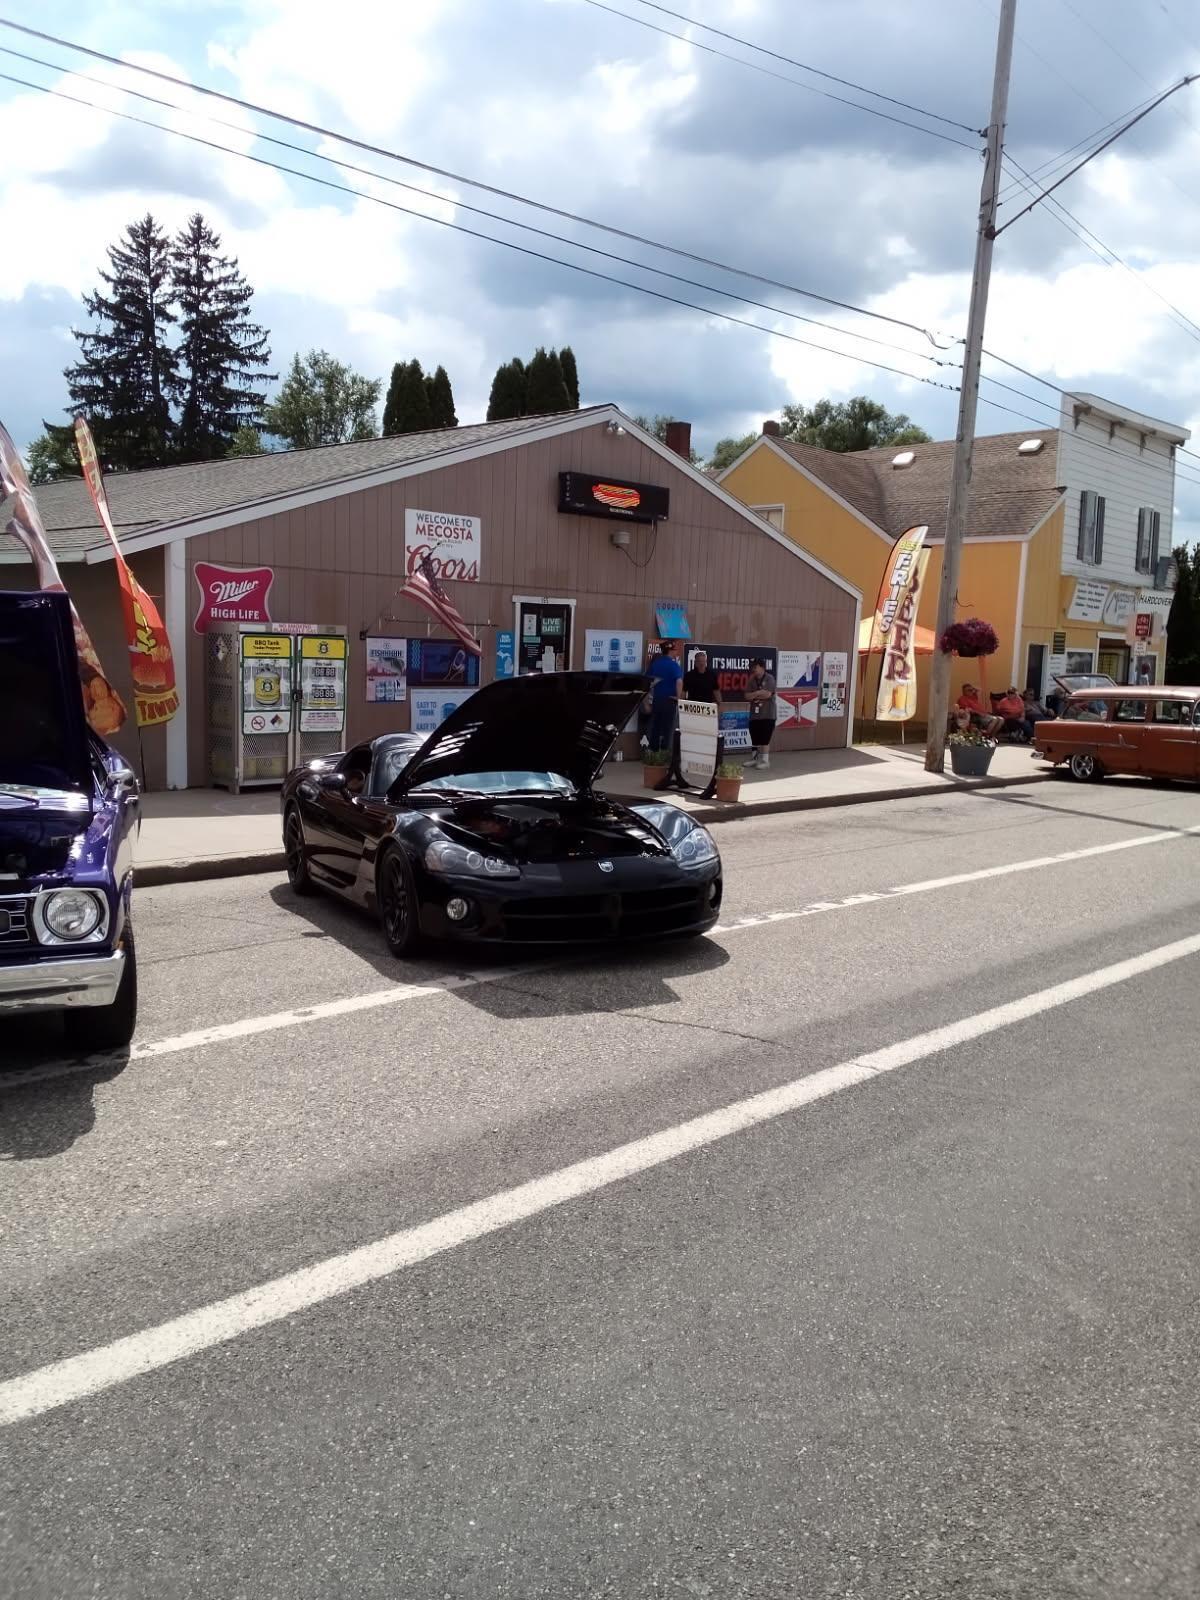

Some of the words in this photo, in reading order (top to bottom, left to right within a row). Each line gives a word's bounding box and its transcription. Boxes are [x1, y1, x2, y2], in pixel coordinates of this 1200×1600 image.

[416, 513, 460, 526] WELCOME
[462, 519, 472, 528] TO
[415, 523, 473, 541] MECOSTA
[406, 544, 478, 581] Coors
[209, 580, 259, 603] Miller
[880, 552, 913, 633] FRIES
[1139, 594, 1172, 606] HARDCOVER
[210, 607, 236, 618] HIGH
[238, 609, 260, 620] LIFE
[542, 618, 561, 626] LIVE
[592, 640, 604, 648] EASY
[647, 643, 662, 655] RIG
[712, 657, 726, 670] IT'S
[726, 658, 750, 670] MILLER
[416, 701, 429, 709] EASY
[683, 703, 711, 716] WOODY'S
